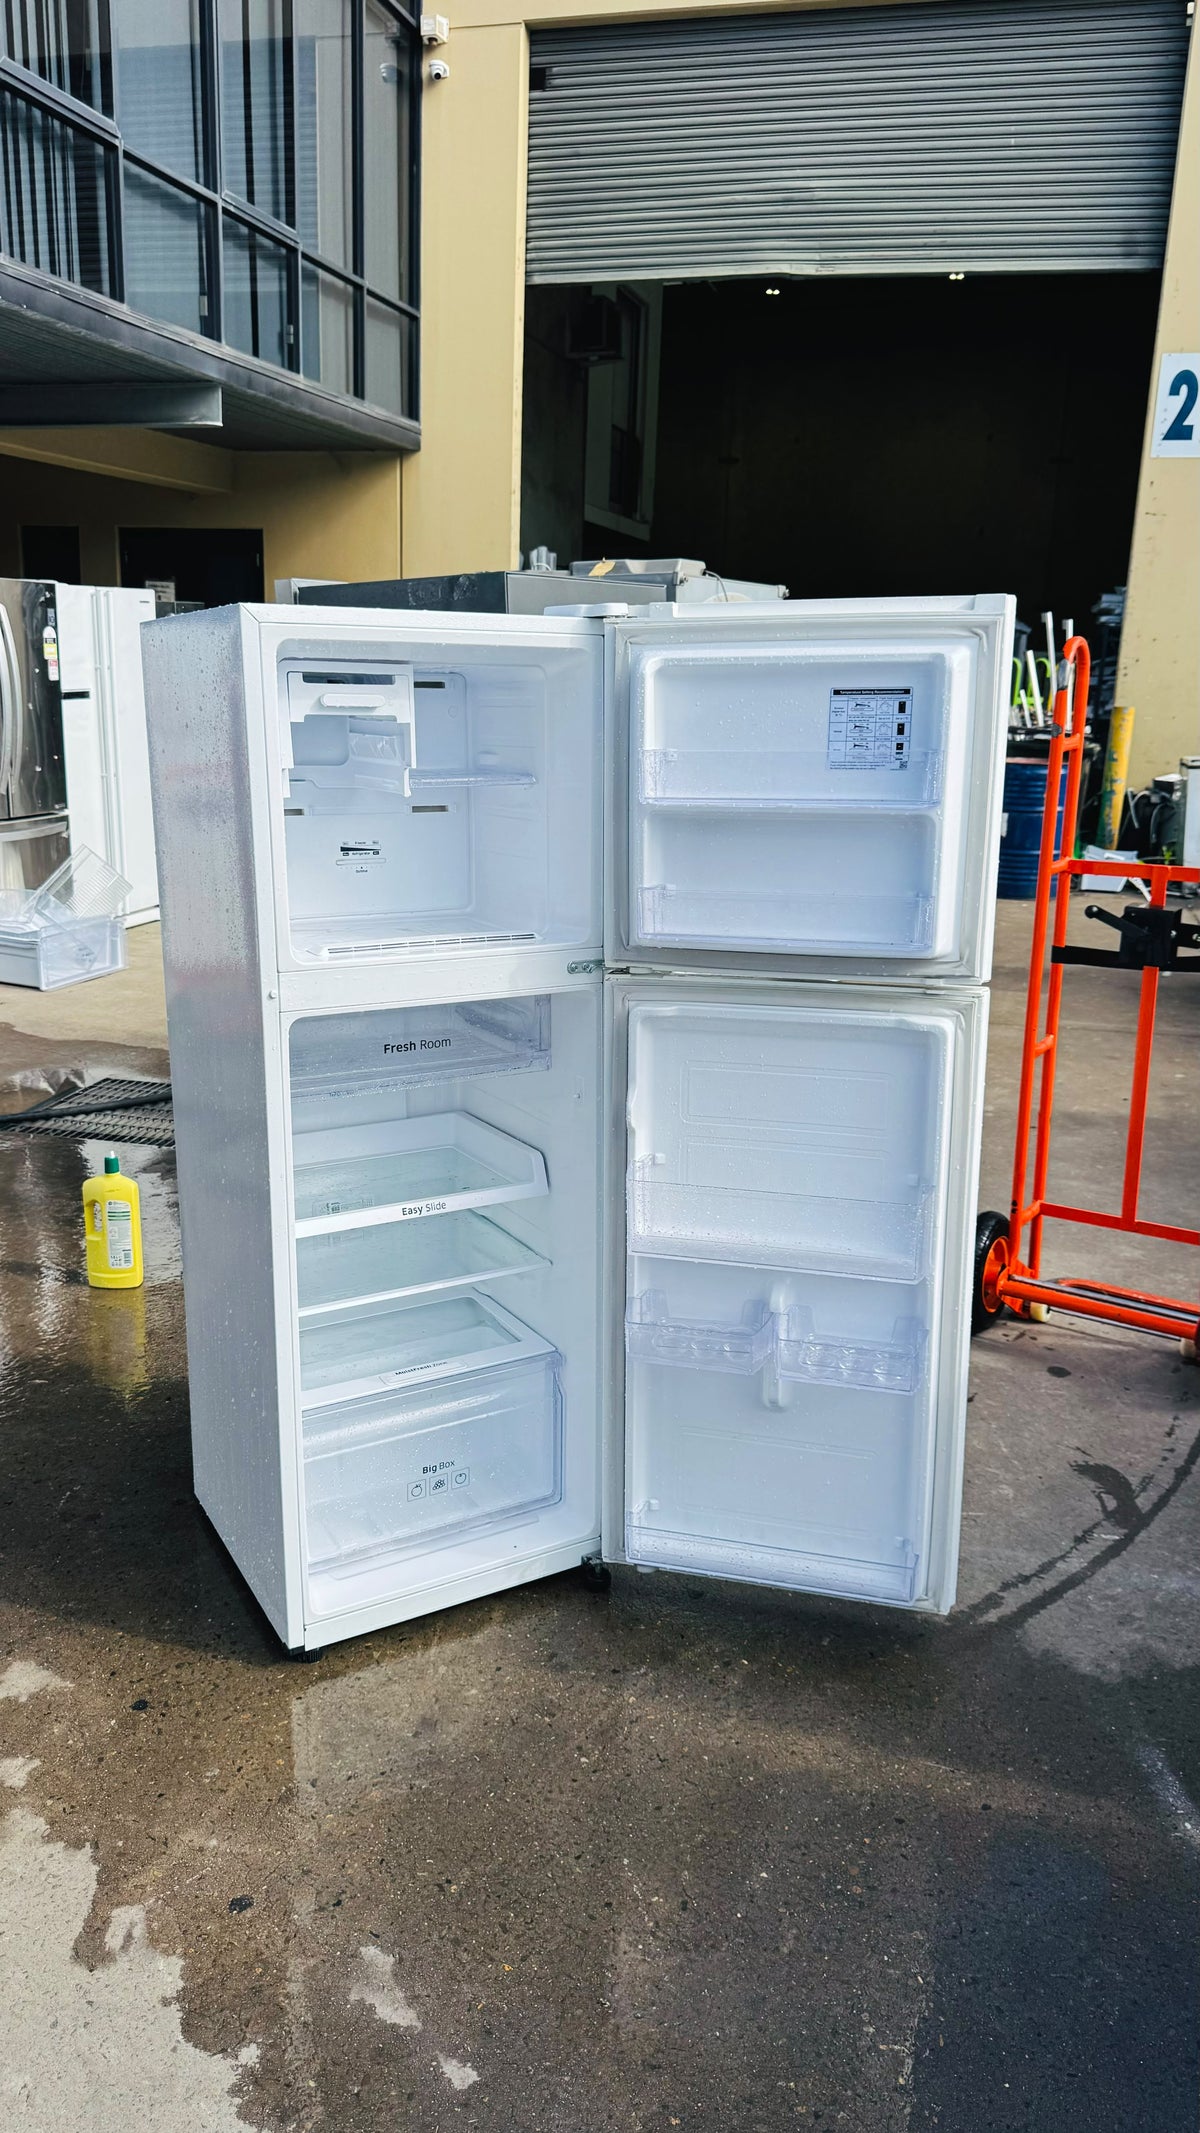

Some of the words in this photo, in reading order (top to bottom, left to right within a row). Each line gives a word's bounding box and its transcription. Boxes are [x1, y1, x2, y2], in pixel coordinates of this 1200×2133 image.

[1161, 369, 1199, 441] 2
[384, 1040, 417, 1054] Fresh
[420, 1038, 452, 1050] Room
[401, 1205, 423, 1216] Easy
[425, 1201, 447, 1213] Slide
[422, 1464, 438, 1474] Big
[439, 1460, 455, 1470] Box
